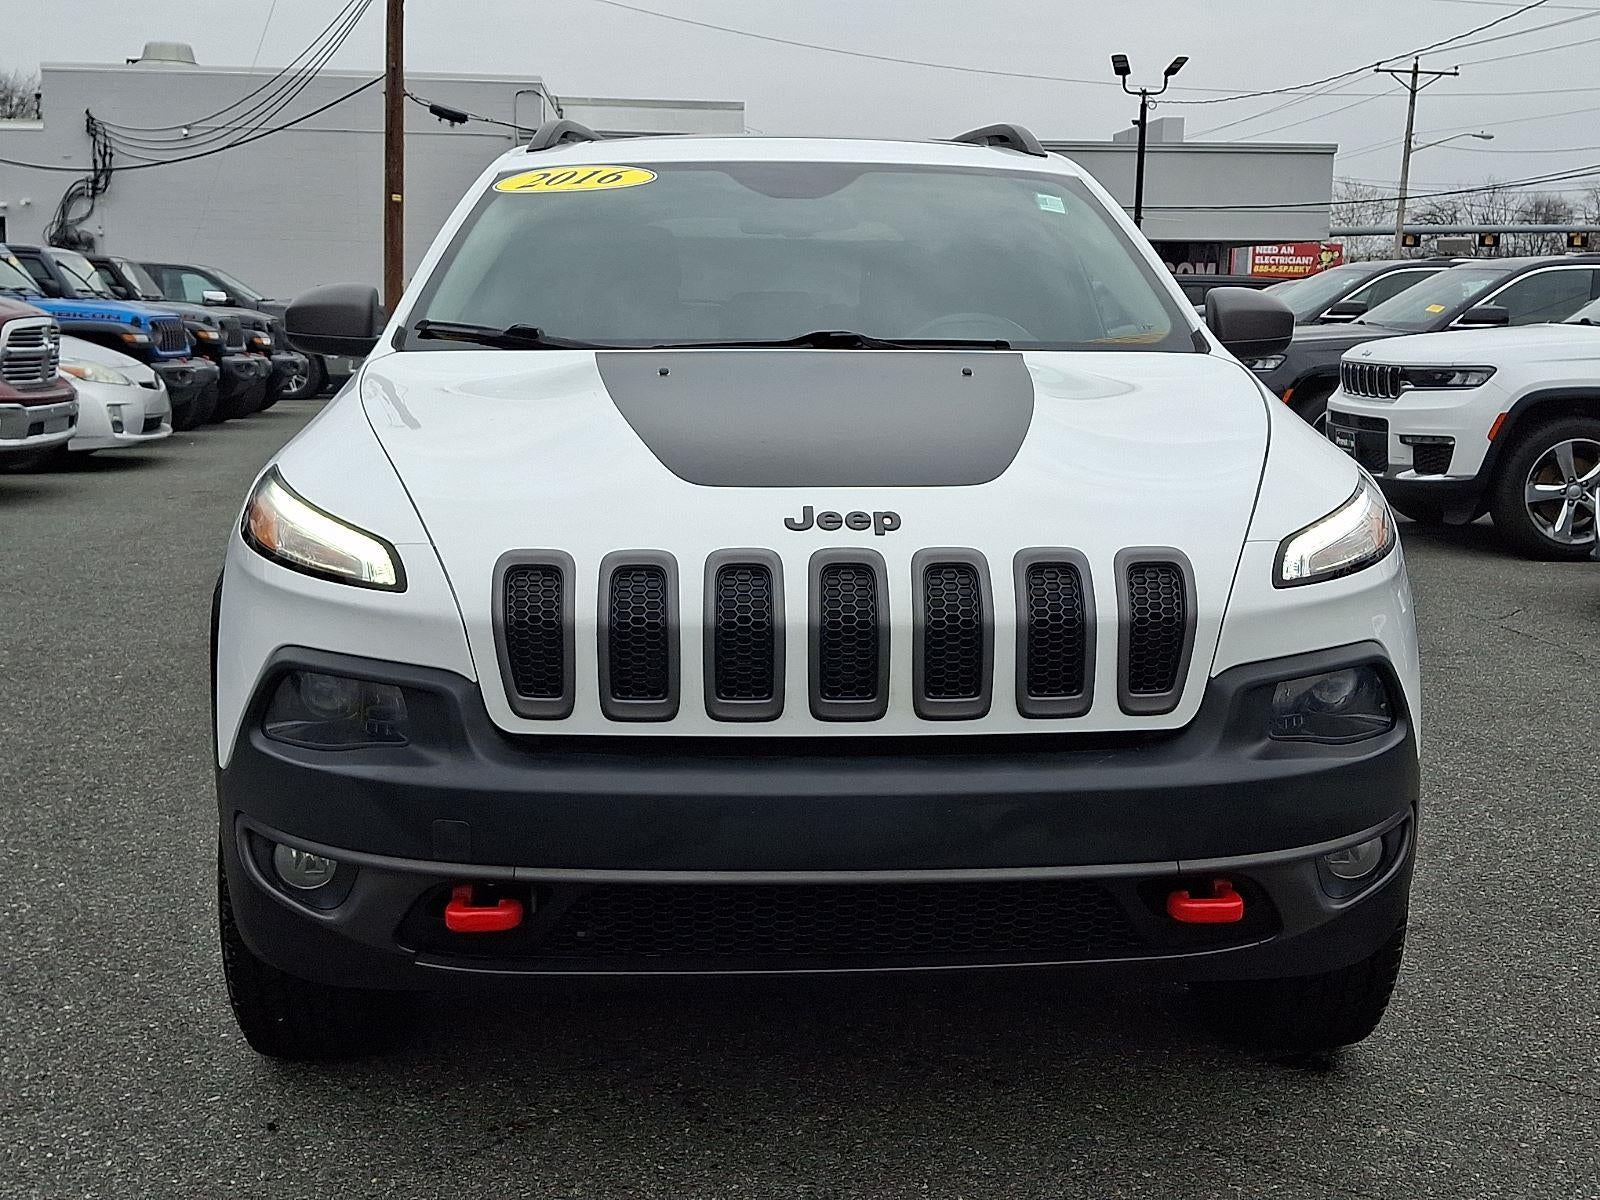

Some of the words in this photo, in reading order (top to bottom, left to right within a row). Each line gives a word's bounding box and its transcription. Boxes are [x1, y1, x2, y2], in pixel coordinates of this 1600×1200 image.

[516, 170, 631, 189] 2016
[1255, 246, 1279, 254] NEED
[1280, 246, 1295, 254] AN
[1254, 255, 1314, 265] ELECTRICIAN?
[784, 505, 901, 535] Jeep
